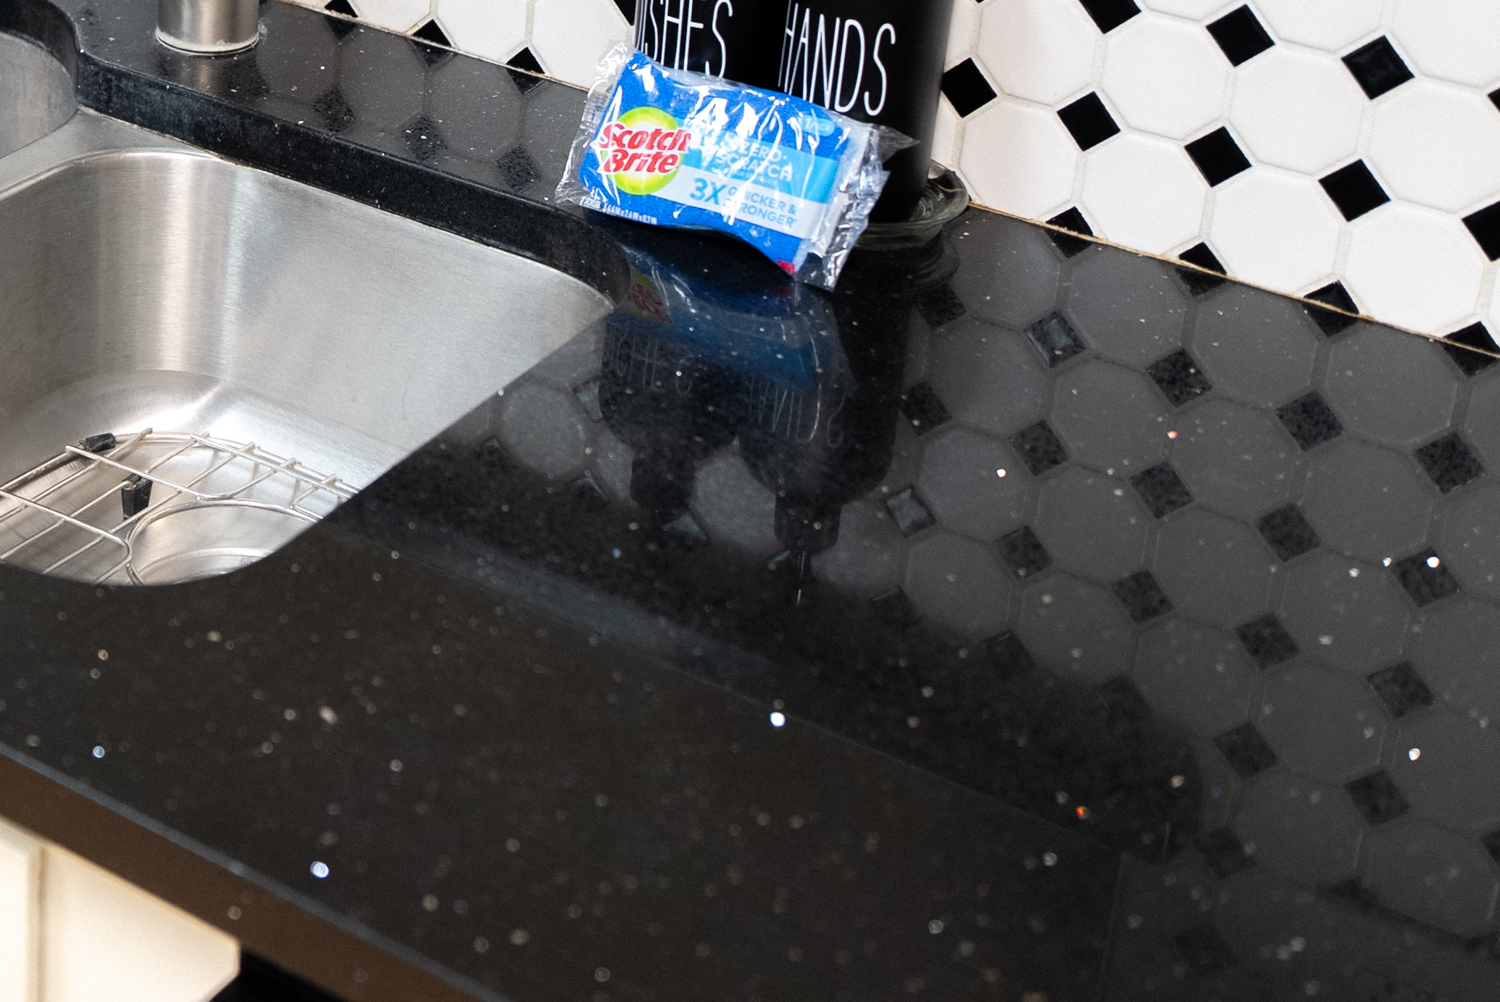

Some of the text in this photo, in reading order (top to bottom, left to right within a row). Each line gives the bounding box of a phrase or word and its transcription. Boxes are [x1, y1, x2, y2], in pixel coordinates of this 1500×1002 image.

[598, 123, 691, 152] Scotch
[603, 148, 679, 174] Brite
[689, 177, 727, 205] 3X
[723, 197, 795, 228] RONGER
